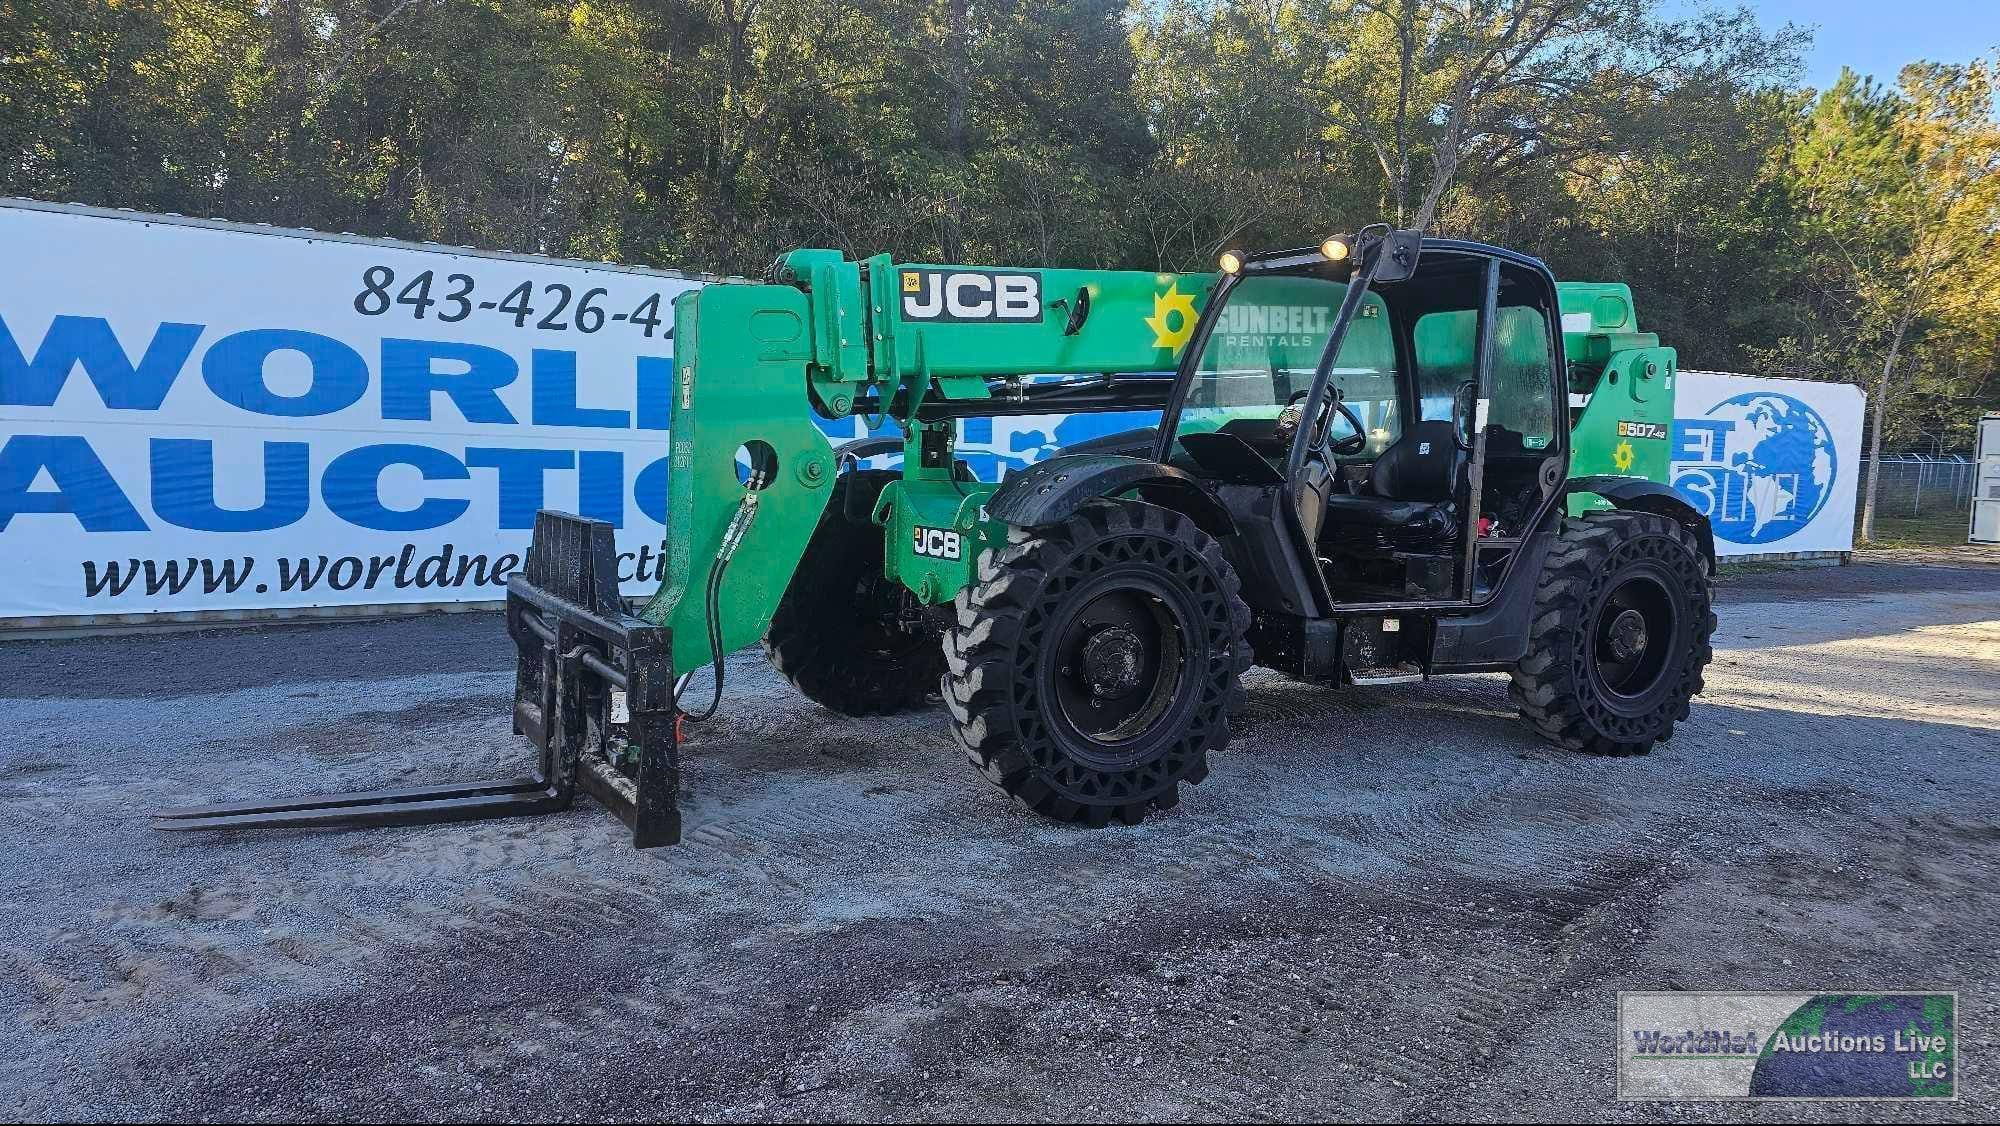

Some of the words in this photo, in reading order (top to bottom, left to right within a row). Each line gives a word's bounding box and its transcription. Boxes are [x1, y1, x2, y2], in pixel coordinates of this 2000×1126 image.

[353, 265, 676, 339] 843-426-4
[904, 273, 1040, 318] JCB
[1214, 305, 1329, 334] SUNBELT
[1226, 336, 1313, 347] RENTALS
[0, 434, 668, 532] AUCTI
[914, 528, 960, 559] JCB
